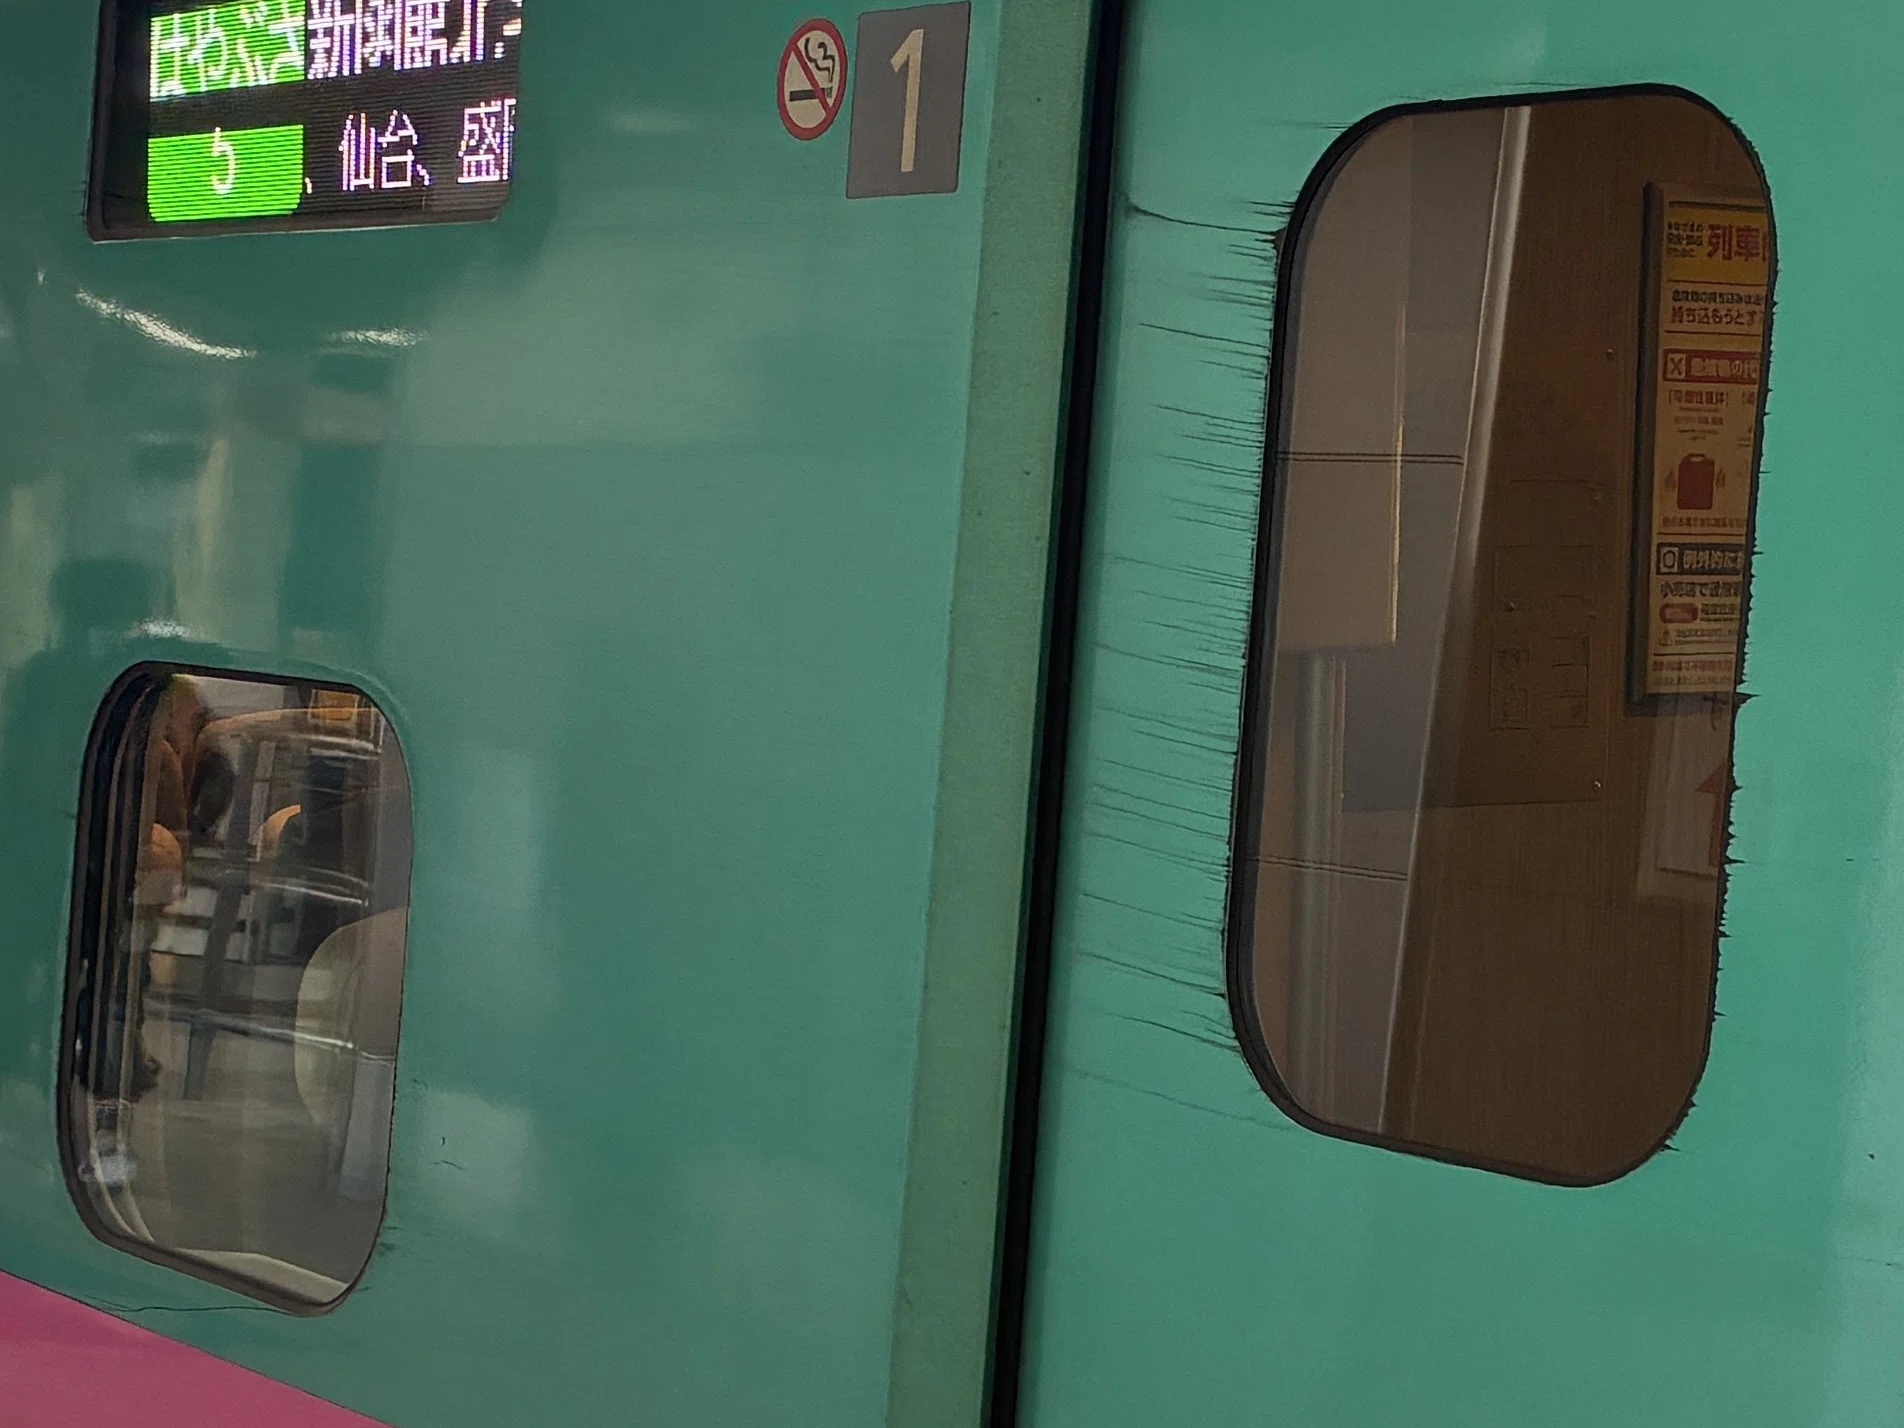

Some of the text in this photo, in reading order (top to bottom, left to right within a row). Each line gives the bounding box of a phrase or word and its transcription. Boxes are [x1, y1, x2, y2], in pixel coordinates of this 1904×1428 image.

[890, 28, 925, 173] 1
[210, 125, 236, 195] 5
[1707, 222, 1767, 262] 列車
